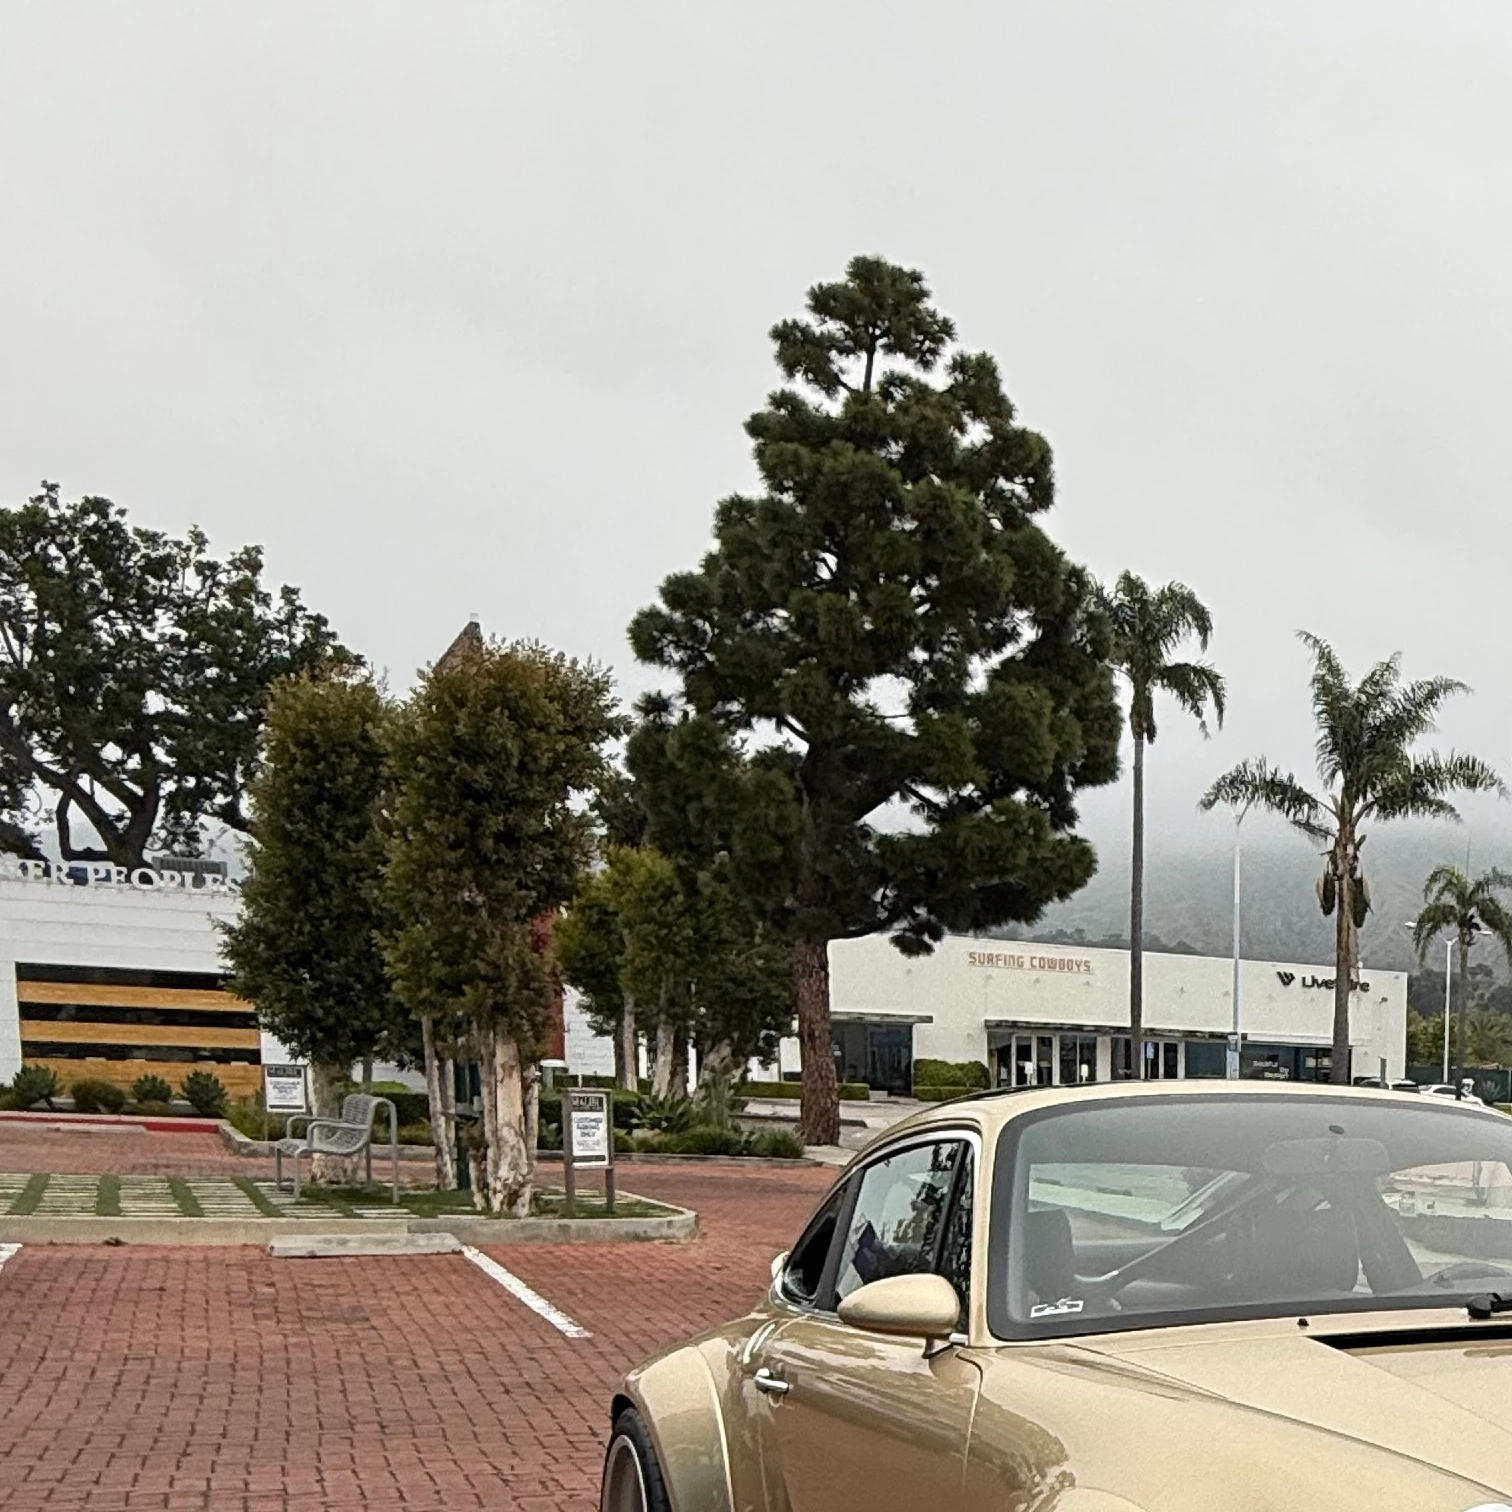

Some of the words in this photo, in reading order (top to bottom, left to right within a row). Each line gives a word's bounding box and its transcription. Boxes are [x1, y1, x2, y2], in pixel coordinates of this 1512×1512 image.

[86, 865, 242, 897] PEOPLES
[968, 951, 1025, 968] SURFING
[1029, 956, 1091, 973] COWBOYS
